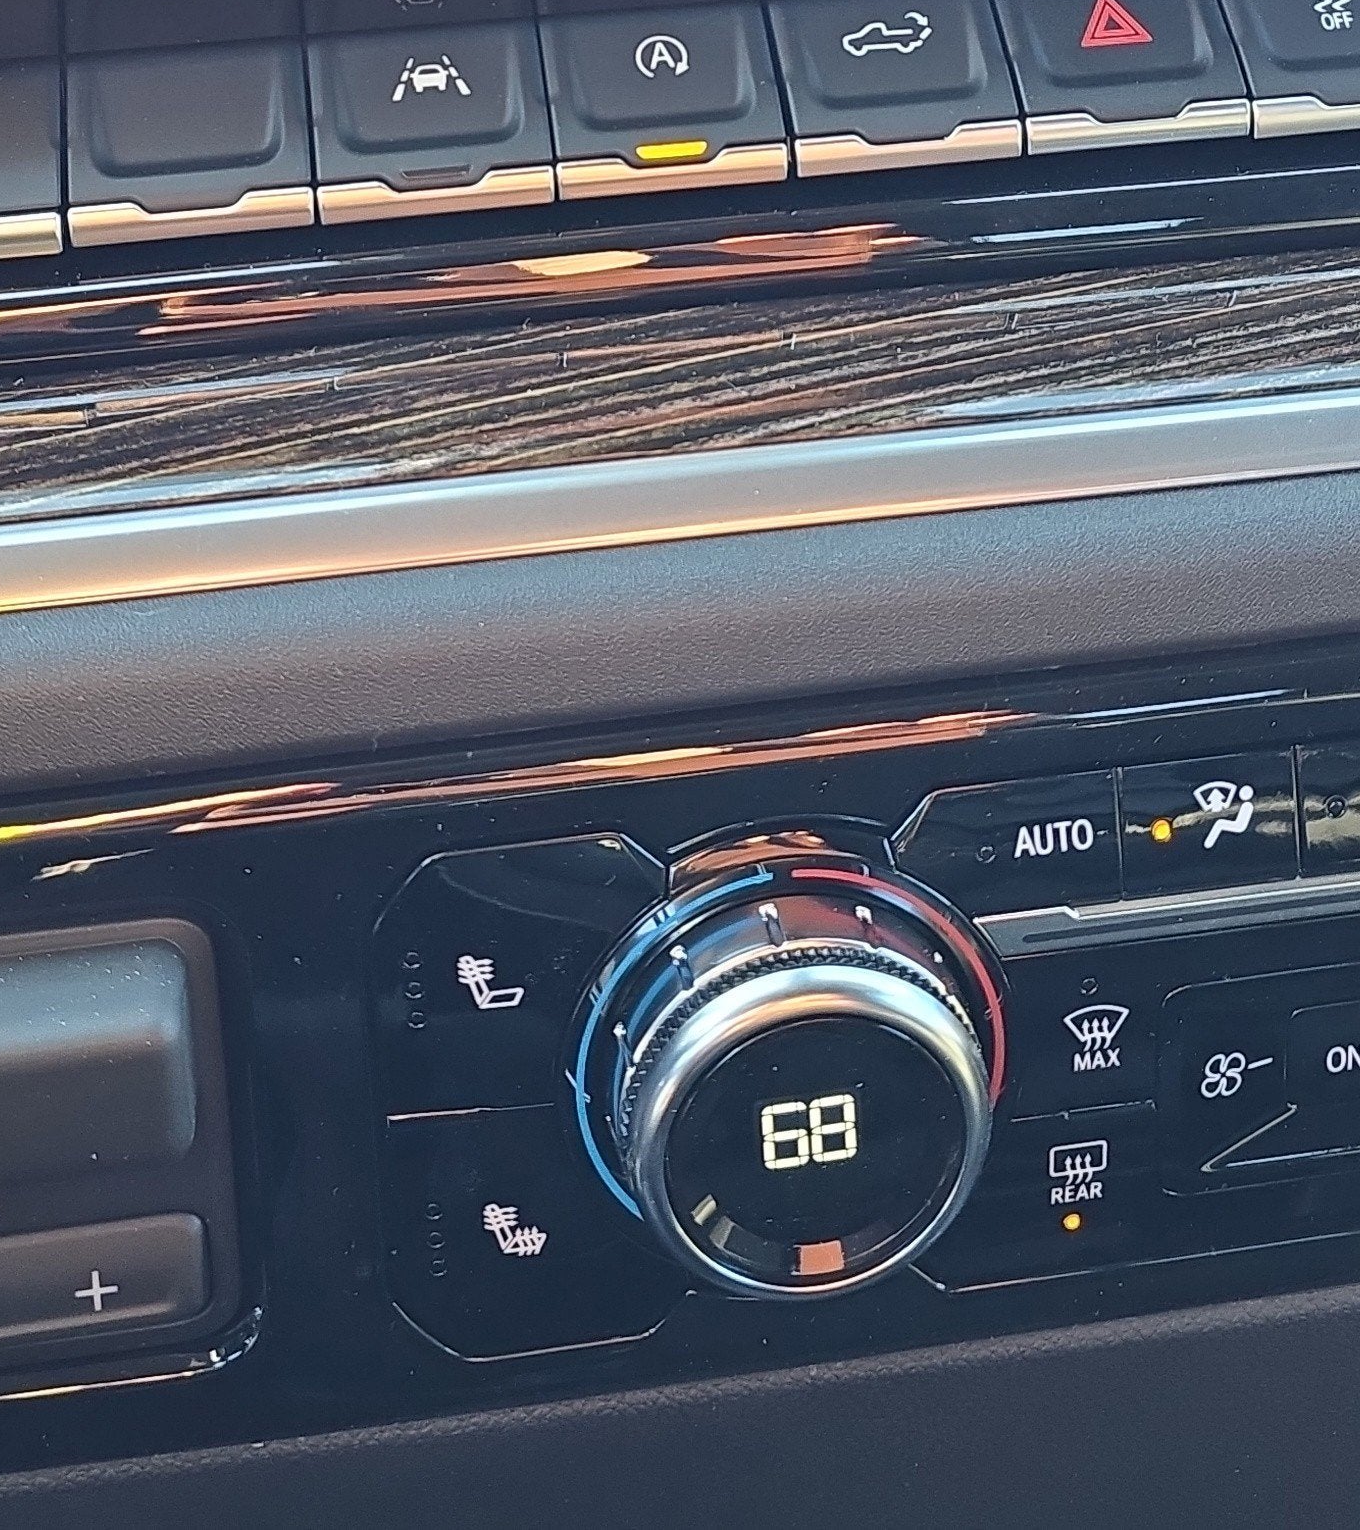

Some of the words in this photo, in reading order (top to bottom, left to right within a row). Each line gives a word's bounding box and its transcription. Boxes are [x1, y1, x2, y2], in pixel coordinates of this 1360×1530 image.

[1321, 11, 1354, 30] OFF
[1014, 818, 1094, 858] AUTO
[1073, 1050, 1121, 1071] MAX
[760, 1092, 859, 1170] 68
[1050, 1183, 1102, 1205] REAR
